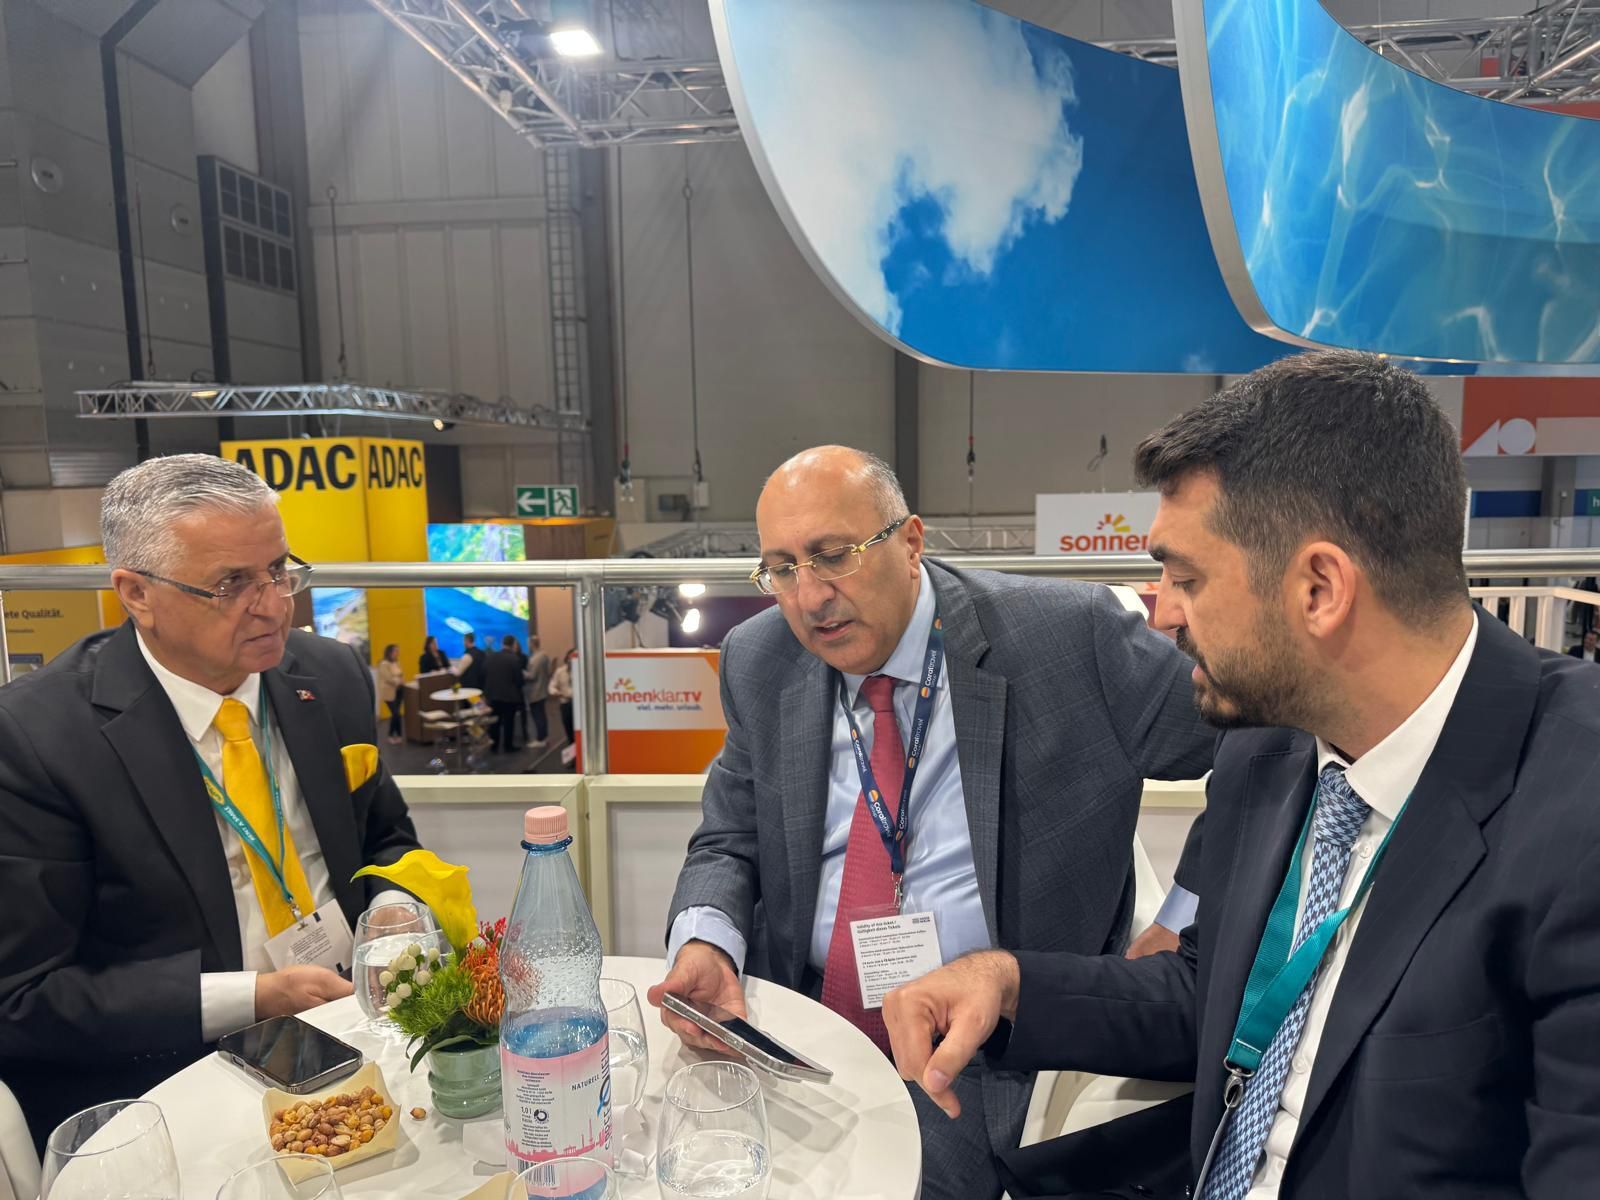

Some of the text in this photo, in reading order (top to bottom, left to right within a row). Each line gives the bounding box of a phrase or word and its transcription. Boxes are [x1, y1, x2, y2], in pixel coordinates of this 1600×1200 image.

[235, 444, 357, 491] ADAC
[368, 444, 423, 489] ADAC
[22, 608, 64, 620] Qualität.
[571, 1074, 600, 1091] NATURELL
